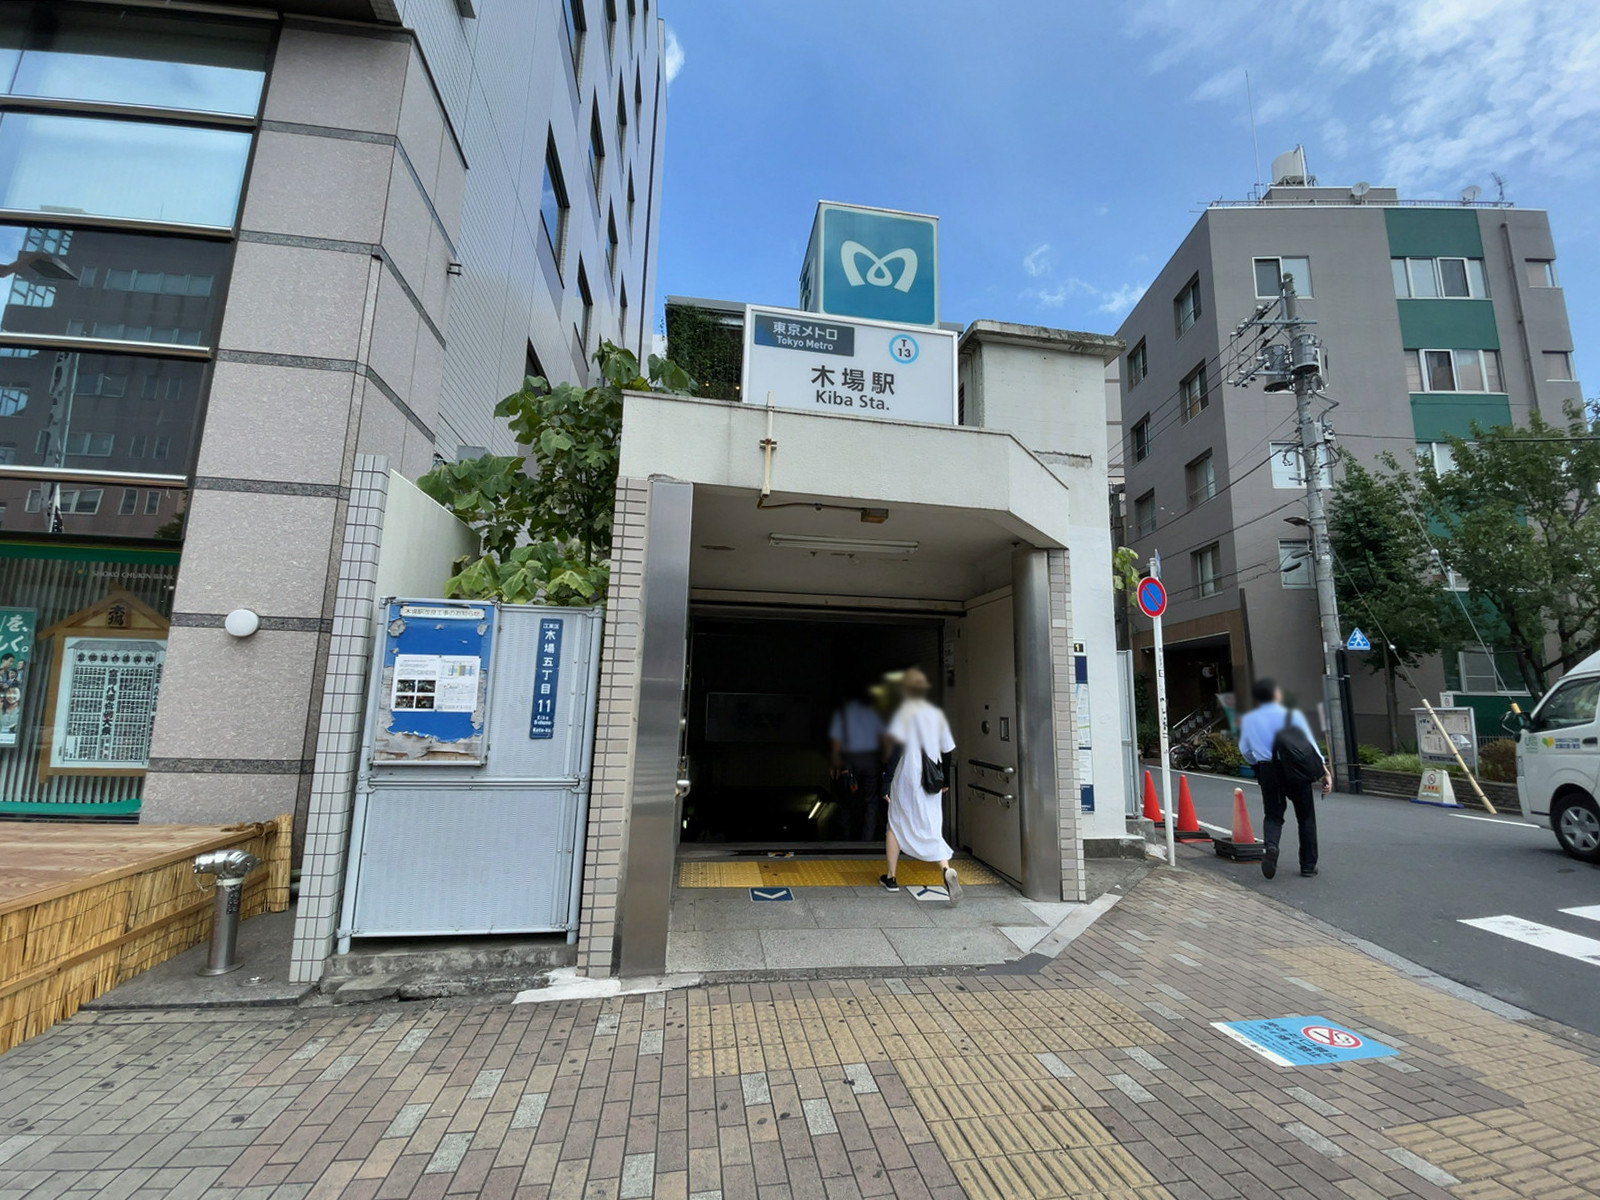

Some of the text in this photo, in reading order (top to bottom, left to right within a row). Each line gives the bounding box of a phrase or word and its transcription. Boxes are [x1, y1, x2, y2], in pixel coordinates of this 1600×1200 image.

[773, 320, 838, 341] 東京メトロ
[777, 335, 834, 351] Tokyo Metro
[901, 339, 908, 348] T
[898, 347, 911, 358] 13
[811, 365, 895, 395] 木場駅
[816, 390, 890, 411] Kiba Sta.
[540, 630, 556, 694] 木場五丁目
[538, 699, 551, 713] 11
